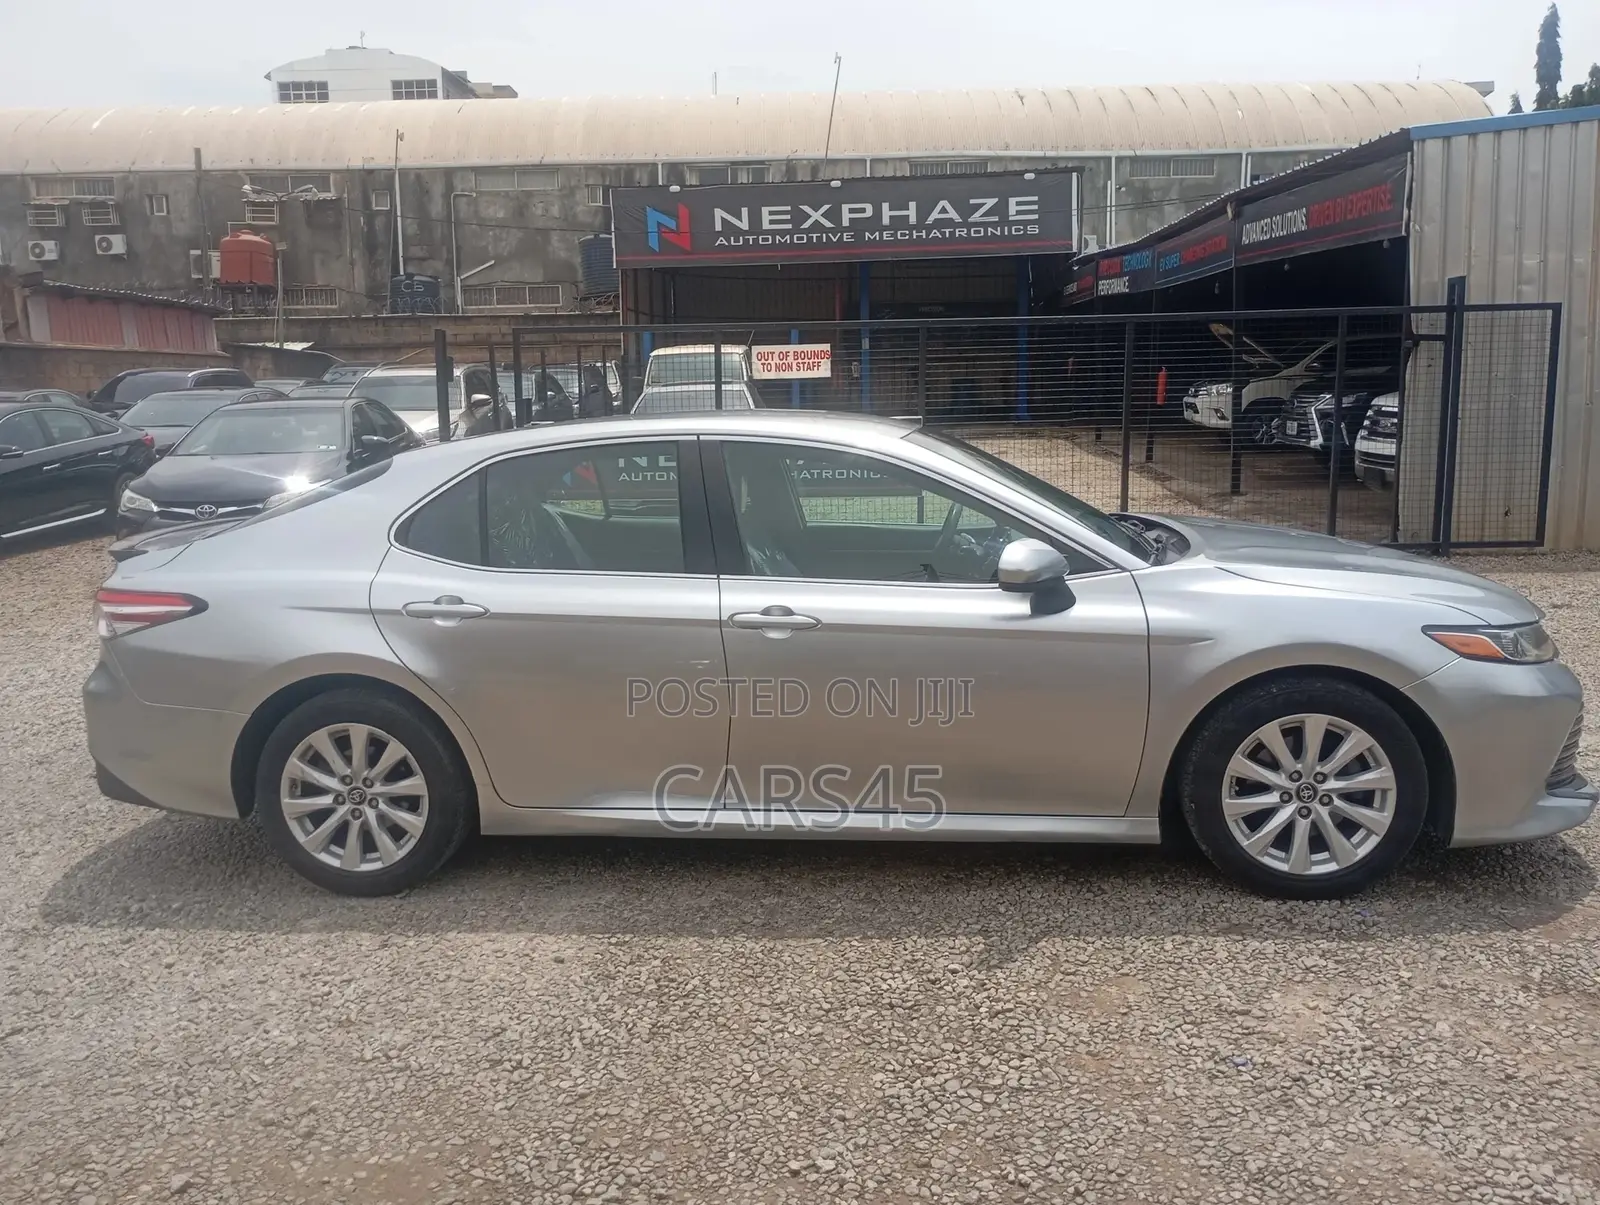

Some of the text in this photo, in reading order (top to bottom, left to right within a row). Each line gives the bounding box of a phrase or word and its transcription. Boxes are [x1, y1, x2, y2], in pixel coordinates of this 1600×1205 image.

[714, 196, 1039, 231] NEXPHAZE
[1241, 217, 1271, 245] ADVANCED
[1335, 197, 1345, 224] BY
[714, 225, 1039, 247] AUTOMOTIVE MECHATRONICS
[756, 350, 832, 362] OUT OF BOUNDS
[761, 361, 822, 373] TO NON STAFF
